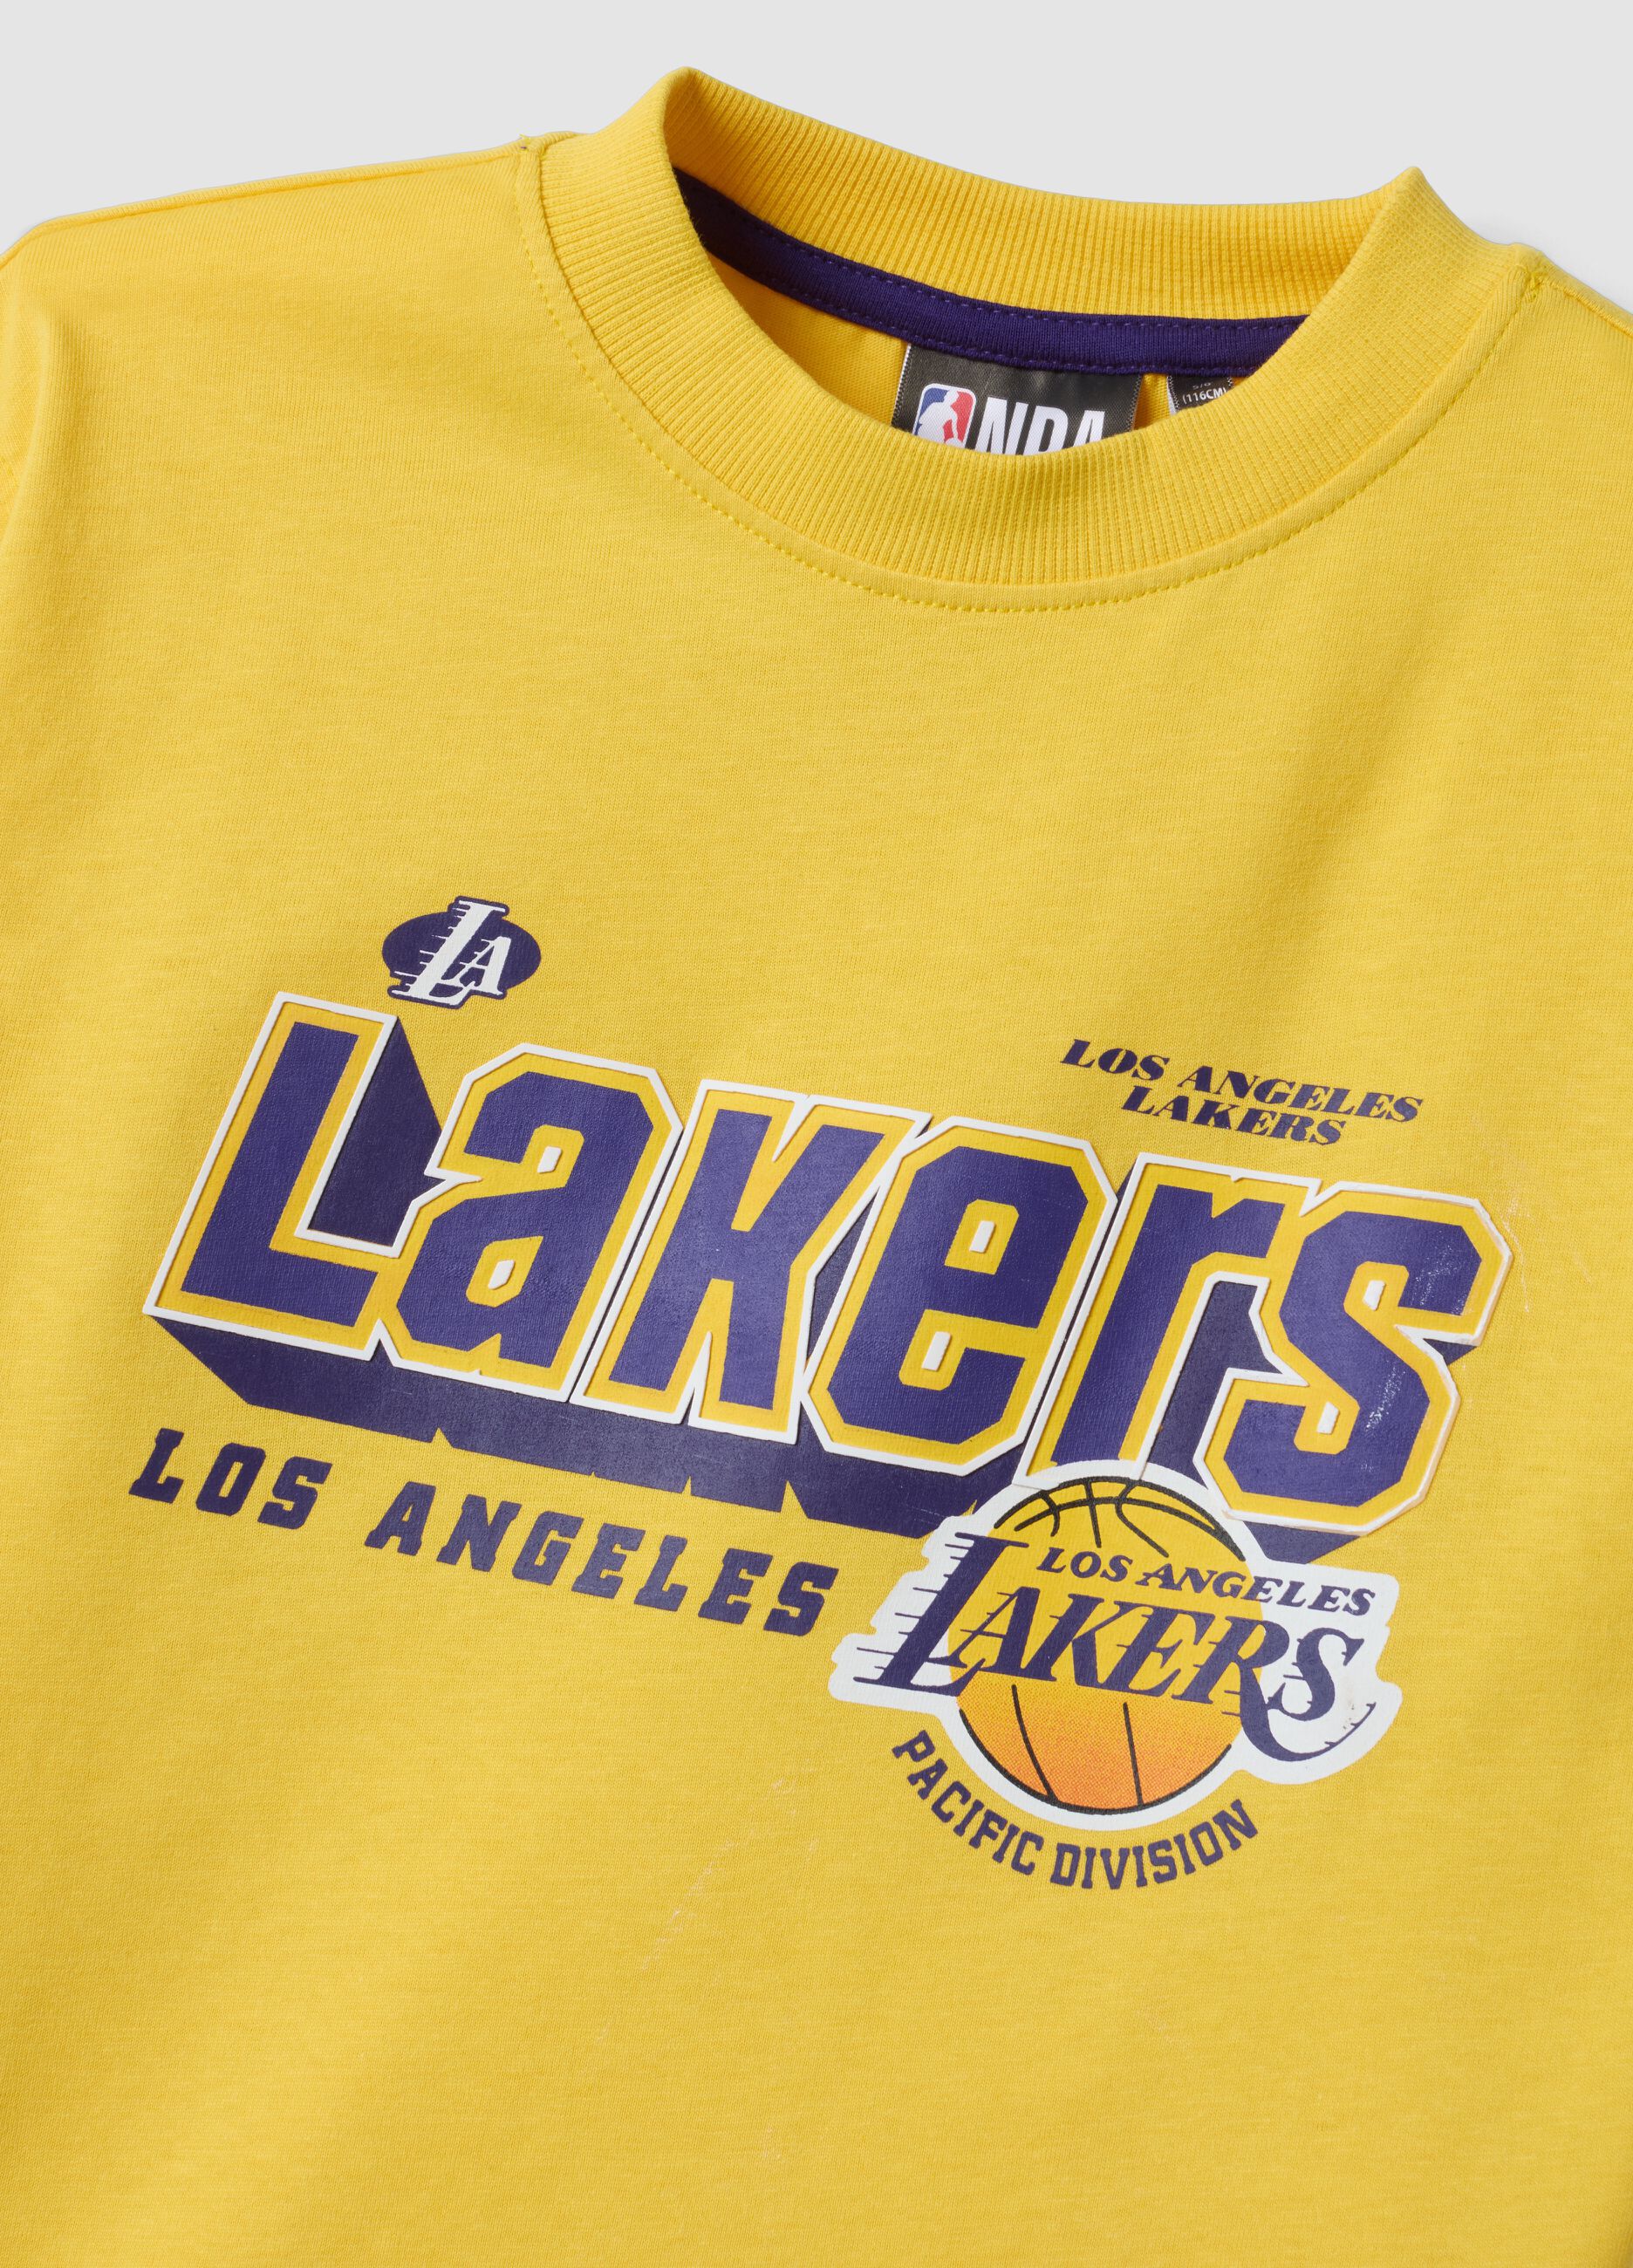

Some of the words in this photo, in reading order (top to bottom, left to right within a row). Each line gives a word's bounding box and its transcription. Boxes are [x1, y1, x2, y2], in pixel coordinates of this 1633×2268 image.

[391, 899, 512, 1006] LA
[1060, 1039, 1170, 1081] LOS
[1178, 1065, 1423, 1123] ANGELES
[1122, 1085, 1346, 1146] LAKERS
[144, 991, 1512, 1535] Lakers
[128, 1428, 332, 1530] LOS
[364, 1481, 838, 1636] ANGELES
[1036, 1547, 1133, 1582] LOS
[1134, 1565, 1376, 1617] ANGELES
[853, 1532, 1377, 1763] LAKERS
[892, 1730, 1044, 1875] PACIFIC
[1049, 1799, 1258, 1889] DIVISION
